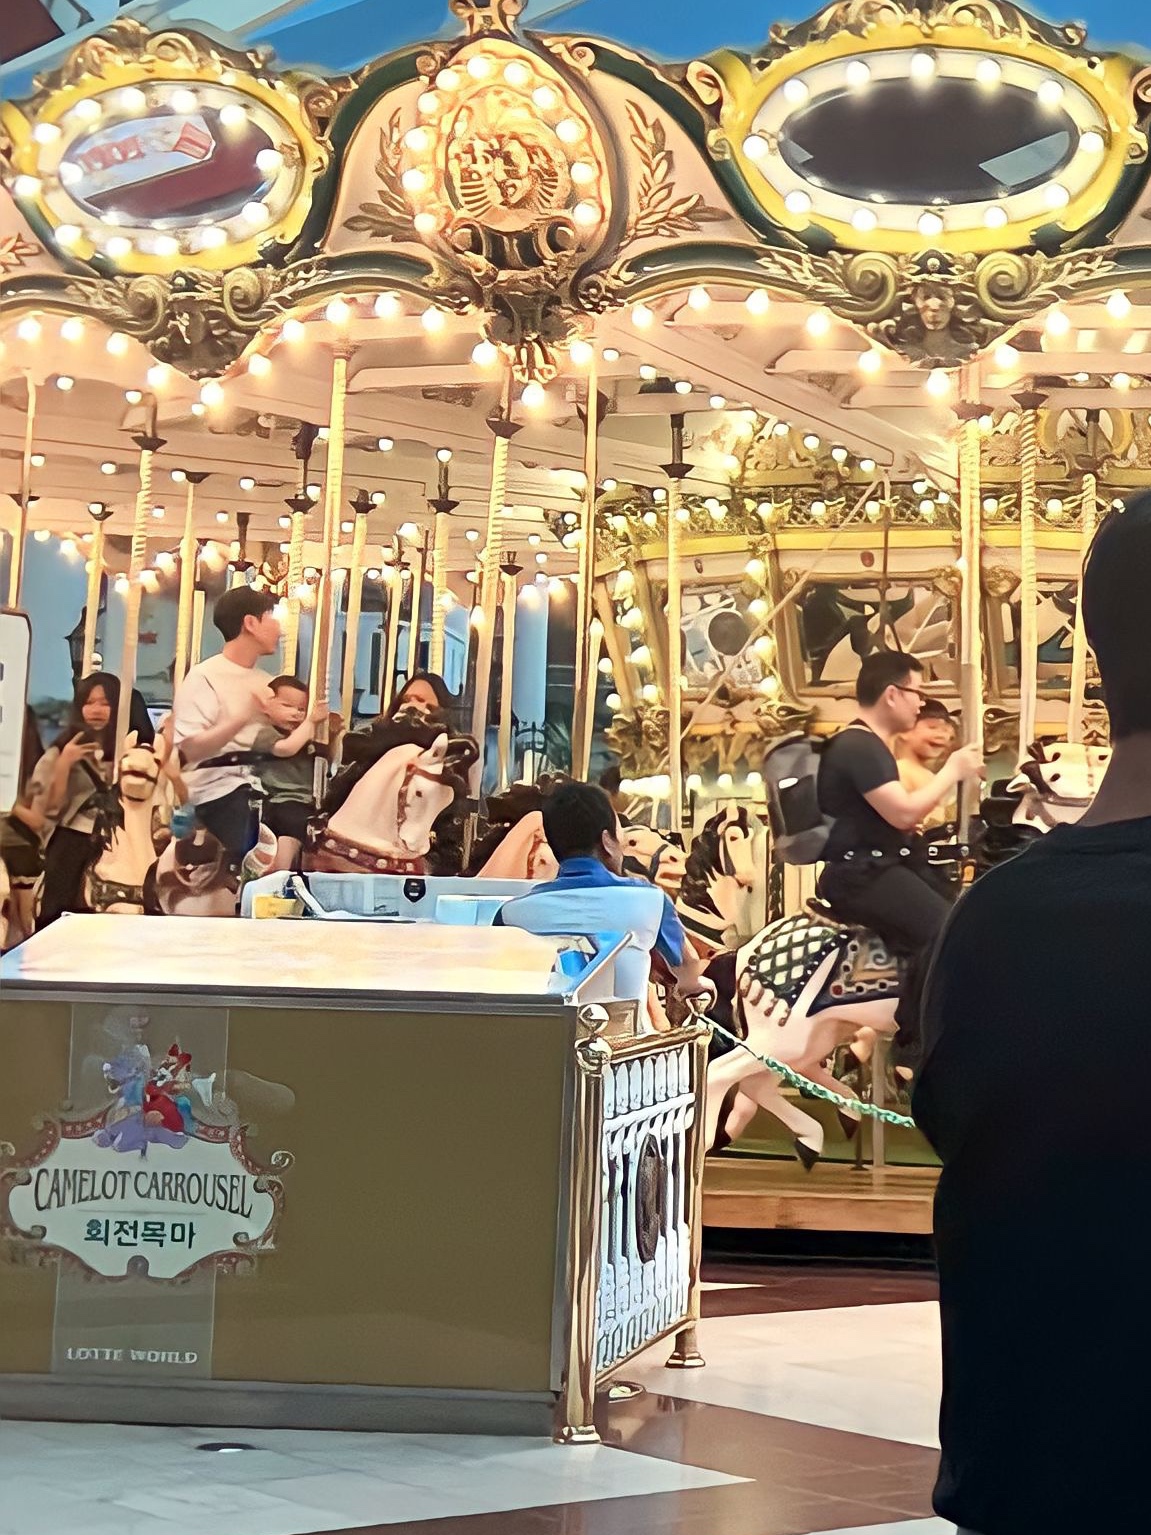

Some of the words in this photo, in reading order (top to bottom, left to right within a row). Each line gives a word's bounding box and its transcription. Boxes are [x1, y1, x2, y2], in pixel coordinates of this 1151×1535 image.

[34, 1168, 131, 1211] CAMELOT
[133, 1171, 253, 1218] CARROUSEL
[84, 1219, 196, 1249] 회전목마
[66, 1347, 123, 1361] LOTTE
[130, 1348, 198, 1364] WORLD
